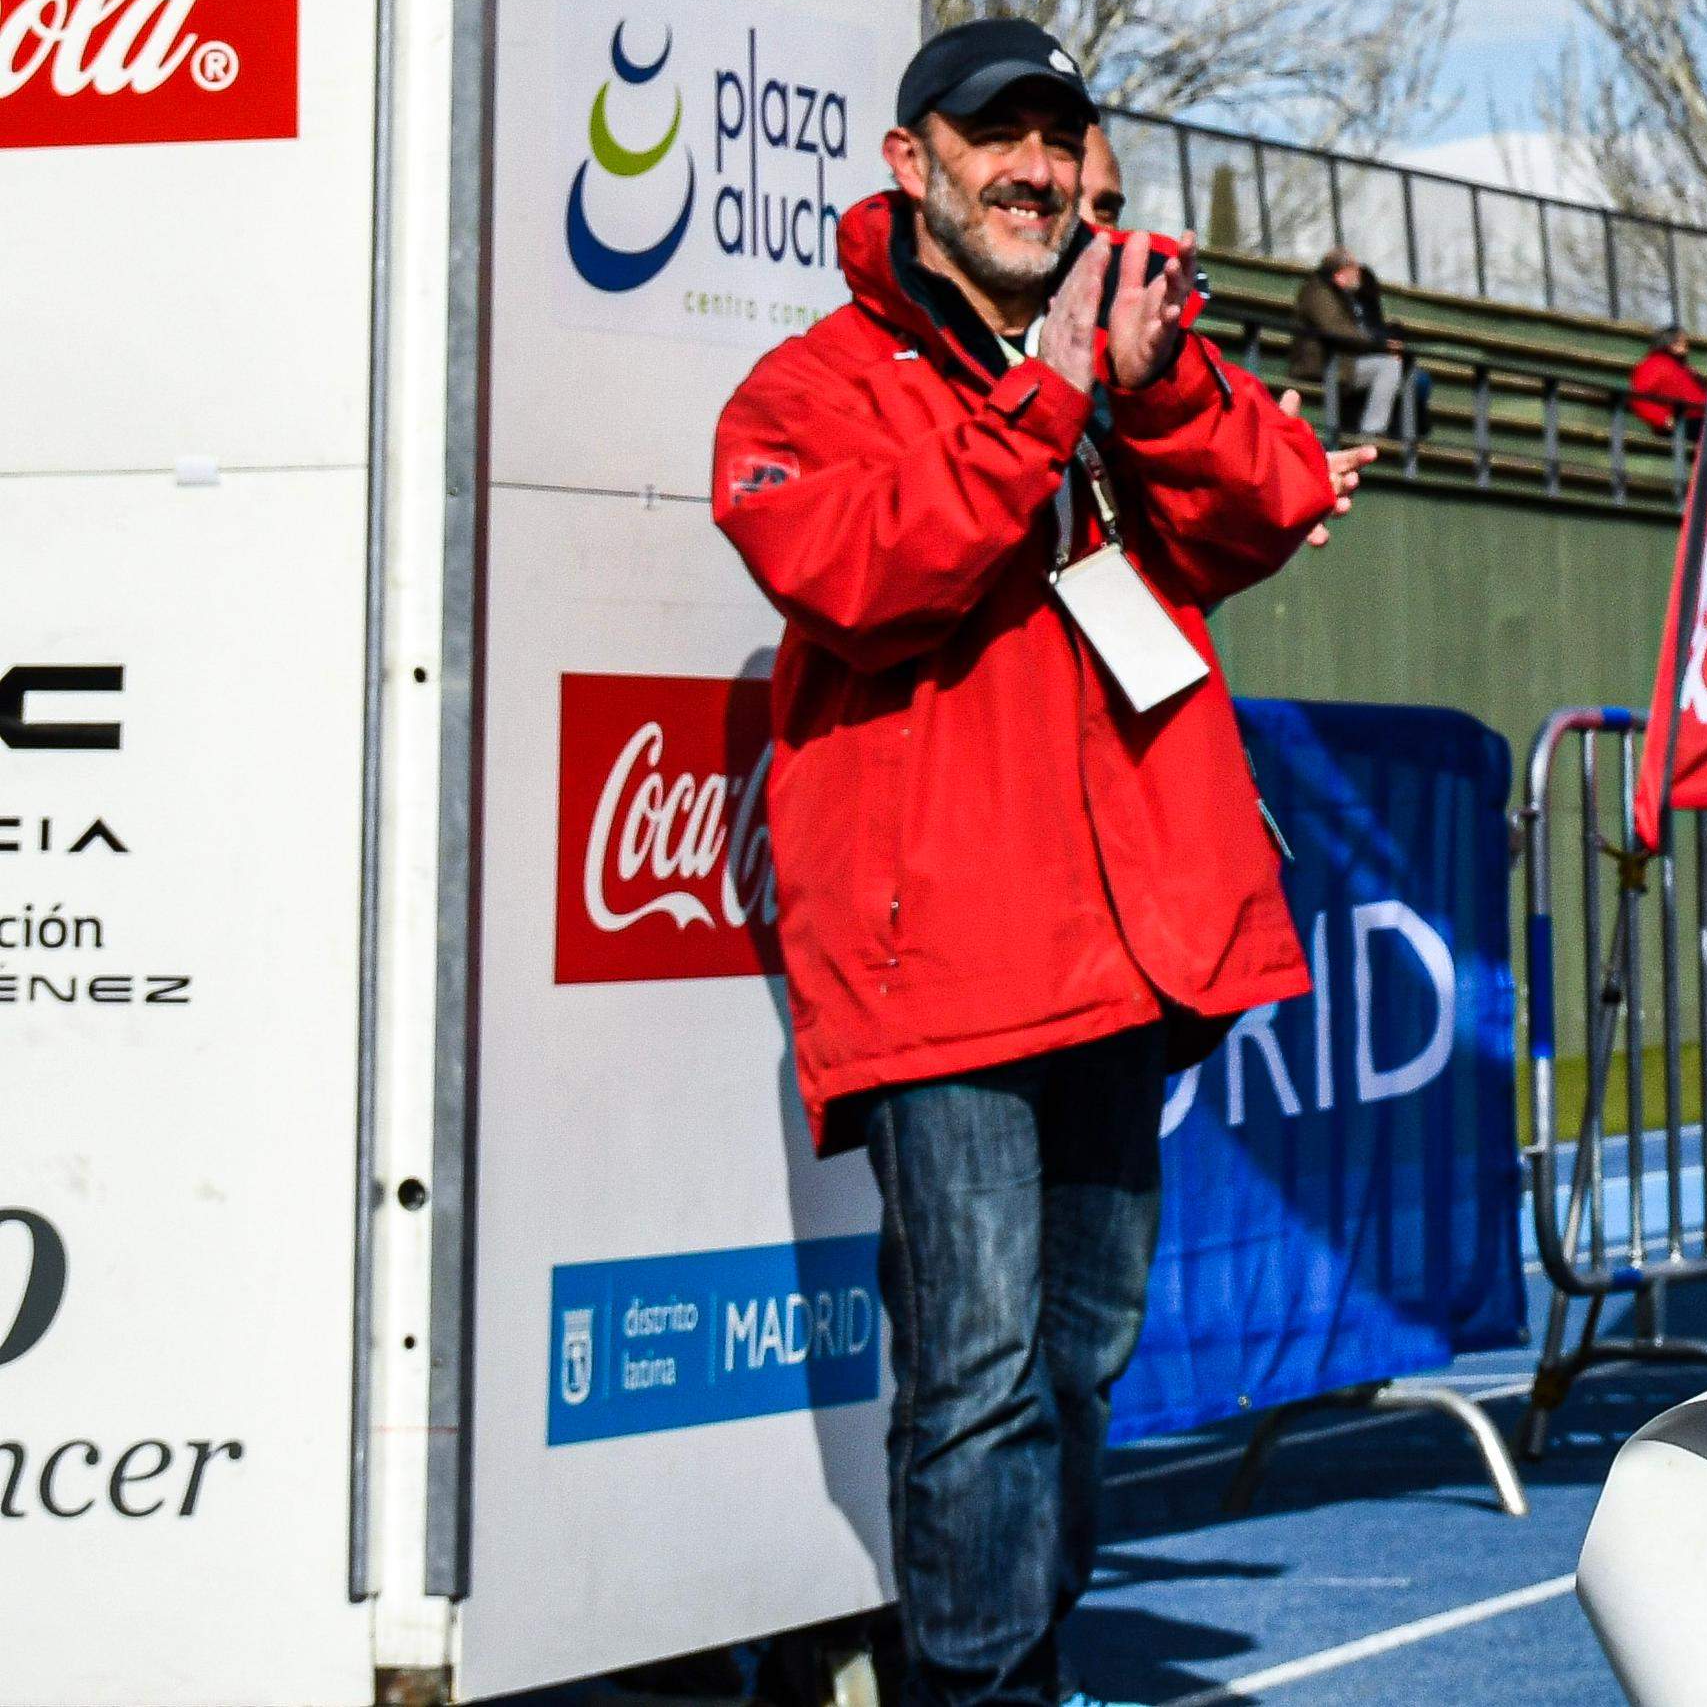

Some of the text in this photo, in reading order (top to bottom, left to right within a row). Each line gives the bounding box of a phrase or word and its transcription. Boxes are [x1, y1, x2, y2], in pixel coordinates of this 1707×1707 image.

[714, 28, 848, 173] plaza
[1159, 899, 1456, 1139] RID
[724, 1287, 873, 1372] MADRID
